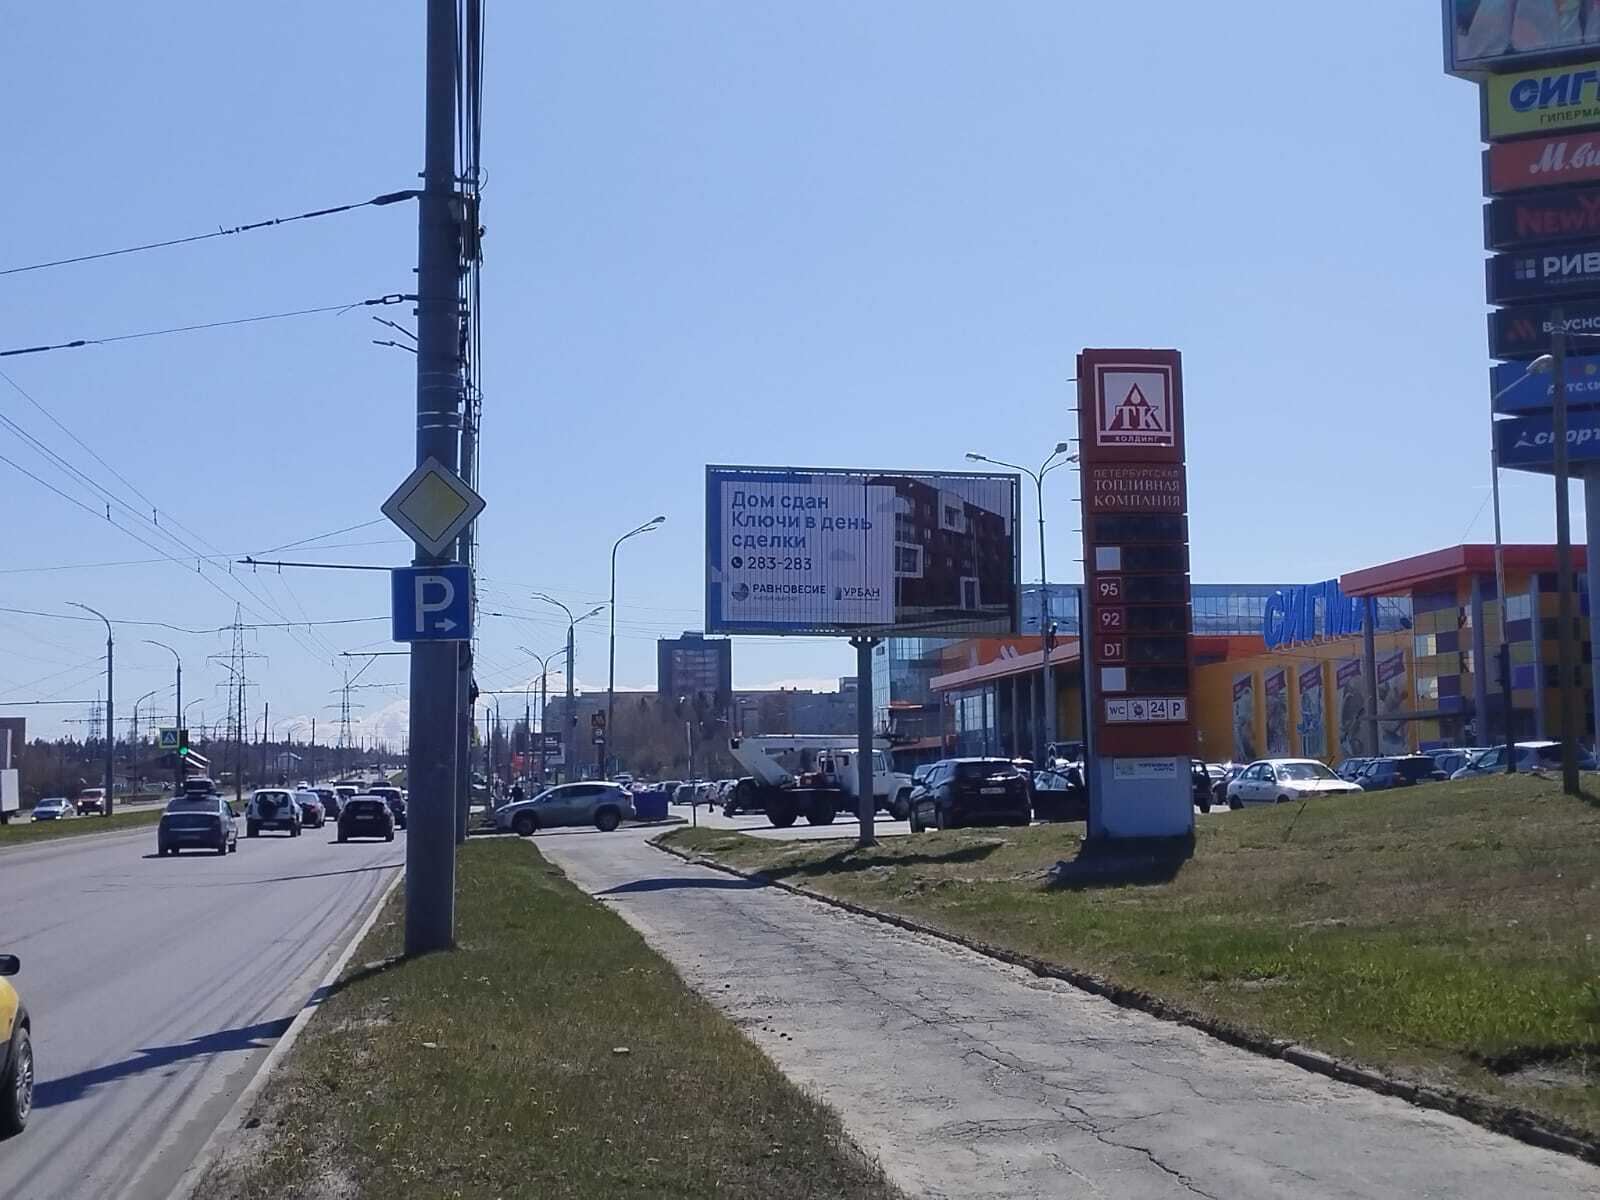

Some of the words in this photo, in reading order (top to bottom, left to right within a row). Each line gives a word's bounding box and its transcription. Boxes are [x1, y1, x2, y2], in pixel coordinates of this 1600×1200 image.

[1510, 70, 1600, 113] СИГ
[1542, 316, 1600, 334] ВУСНО
[1093, 468, 1179, 479] ПЕТЕРБУРГСКАЯ
[1093, 479, 1180, 492] ТОПЛИВНАЯ
[731, 490, 775, 511] Дом
[779, 493, 829, 511] сдан
[1094, 494, 1181, 507] КОМПАНИЯ
[731, 511, 800, 530] Ключи
[804, 517, 817, 529] в
[821, 516, 873, 533] день
[731, 533, 807, 551] сделки
[747, 556, 812, 571] 283-283
[752, 583, 827, 595] РАВНОВЕСИЕ
[843, 586, 881, 598] УРБАН
[1099, 583, 1118, 597] 95
[415, 575, 455, 633] P
[1102, 612, 1120, 627] 92
[1109, 705, 1125, 716] WC
[1150, 701, 1166, 713] 24
[1172, 702, 1181, 717] P
